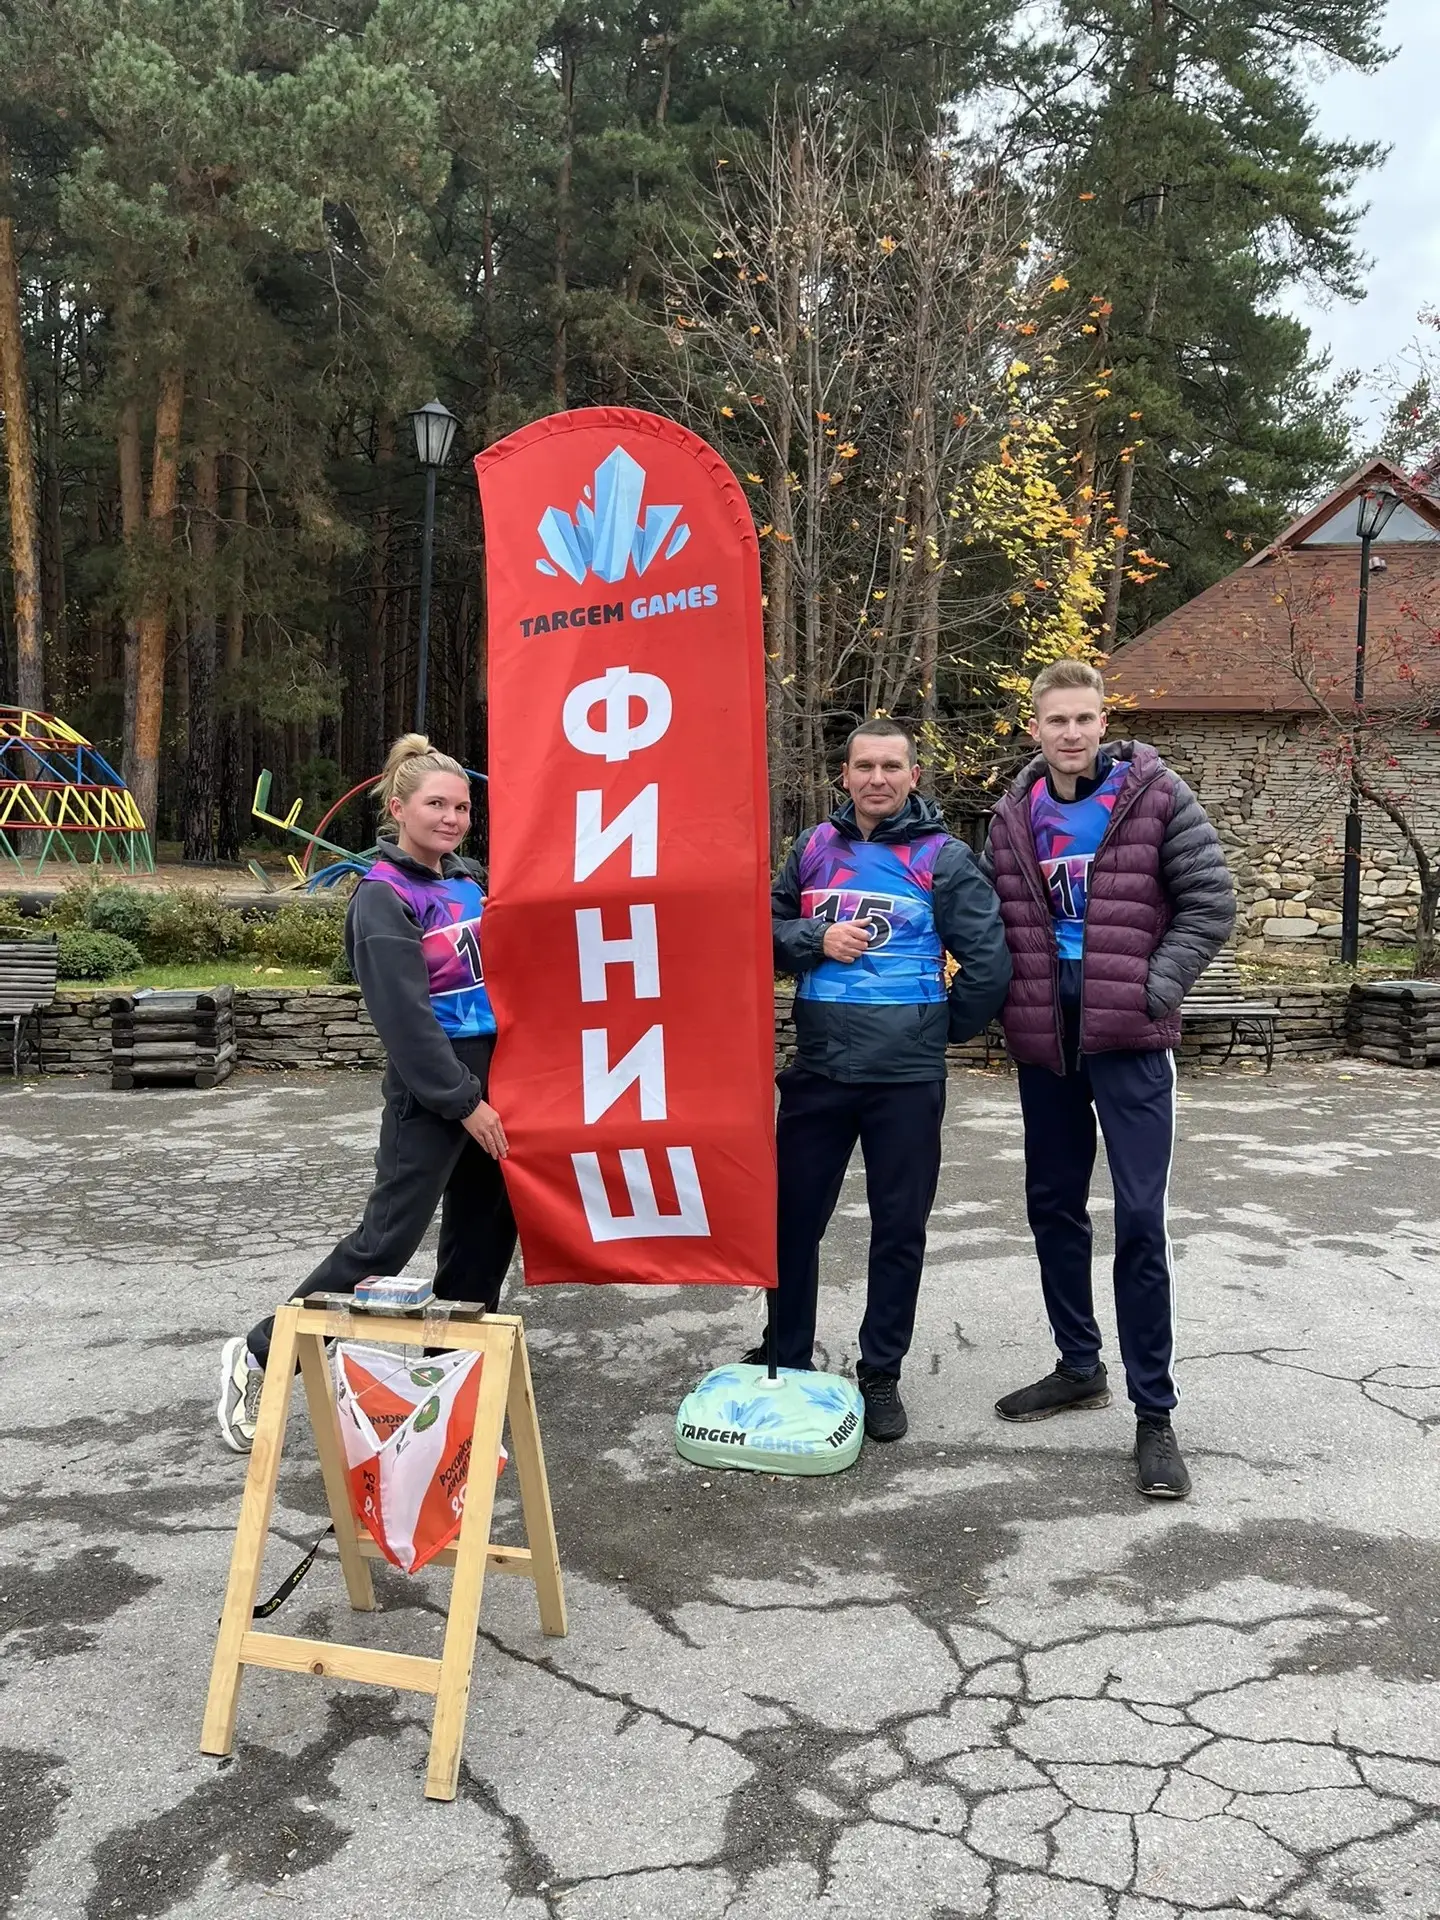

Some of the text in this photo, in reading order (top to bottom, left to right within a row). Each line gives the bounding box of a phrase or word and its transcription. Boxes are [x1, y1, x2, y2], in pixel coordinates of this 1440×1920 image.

[520, 584, 719, 638] TARGEM GAMES
[1048, 859, 1096, 917] 1
[813, 893, 895, 950] 15
[454, 925, 484, 984] 1
[562, 665, 711, 1242] ФИНИШ
[681, 1422, 817, 1455] TARGEM GAMES
[825, 1411, 860, 1449] TARGEM
